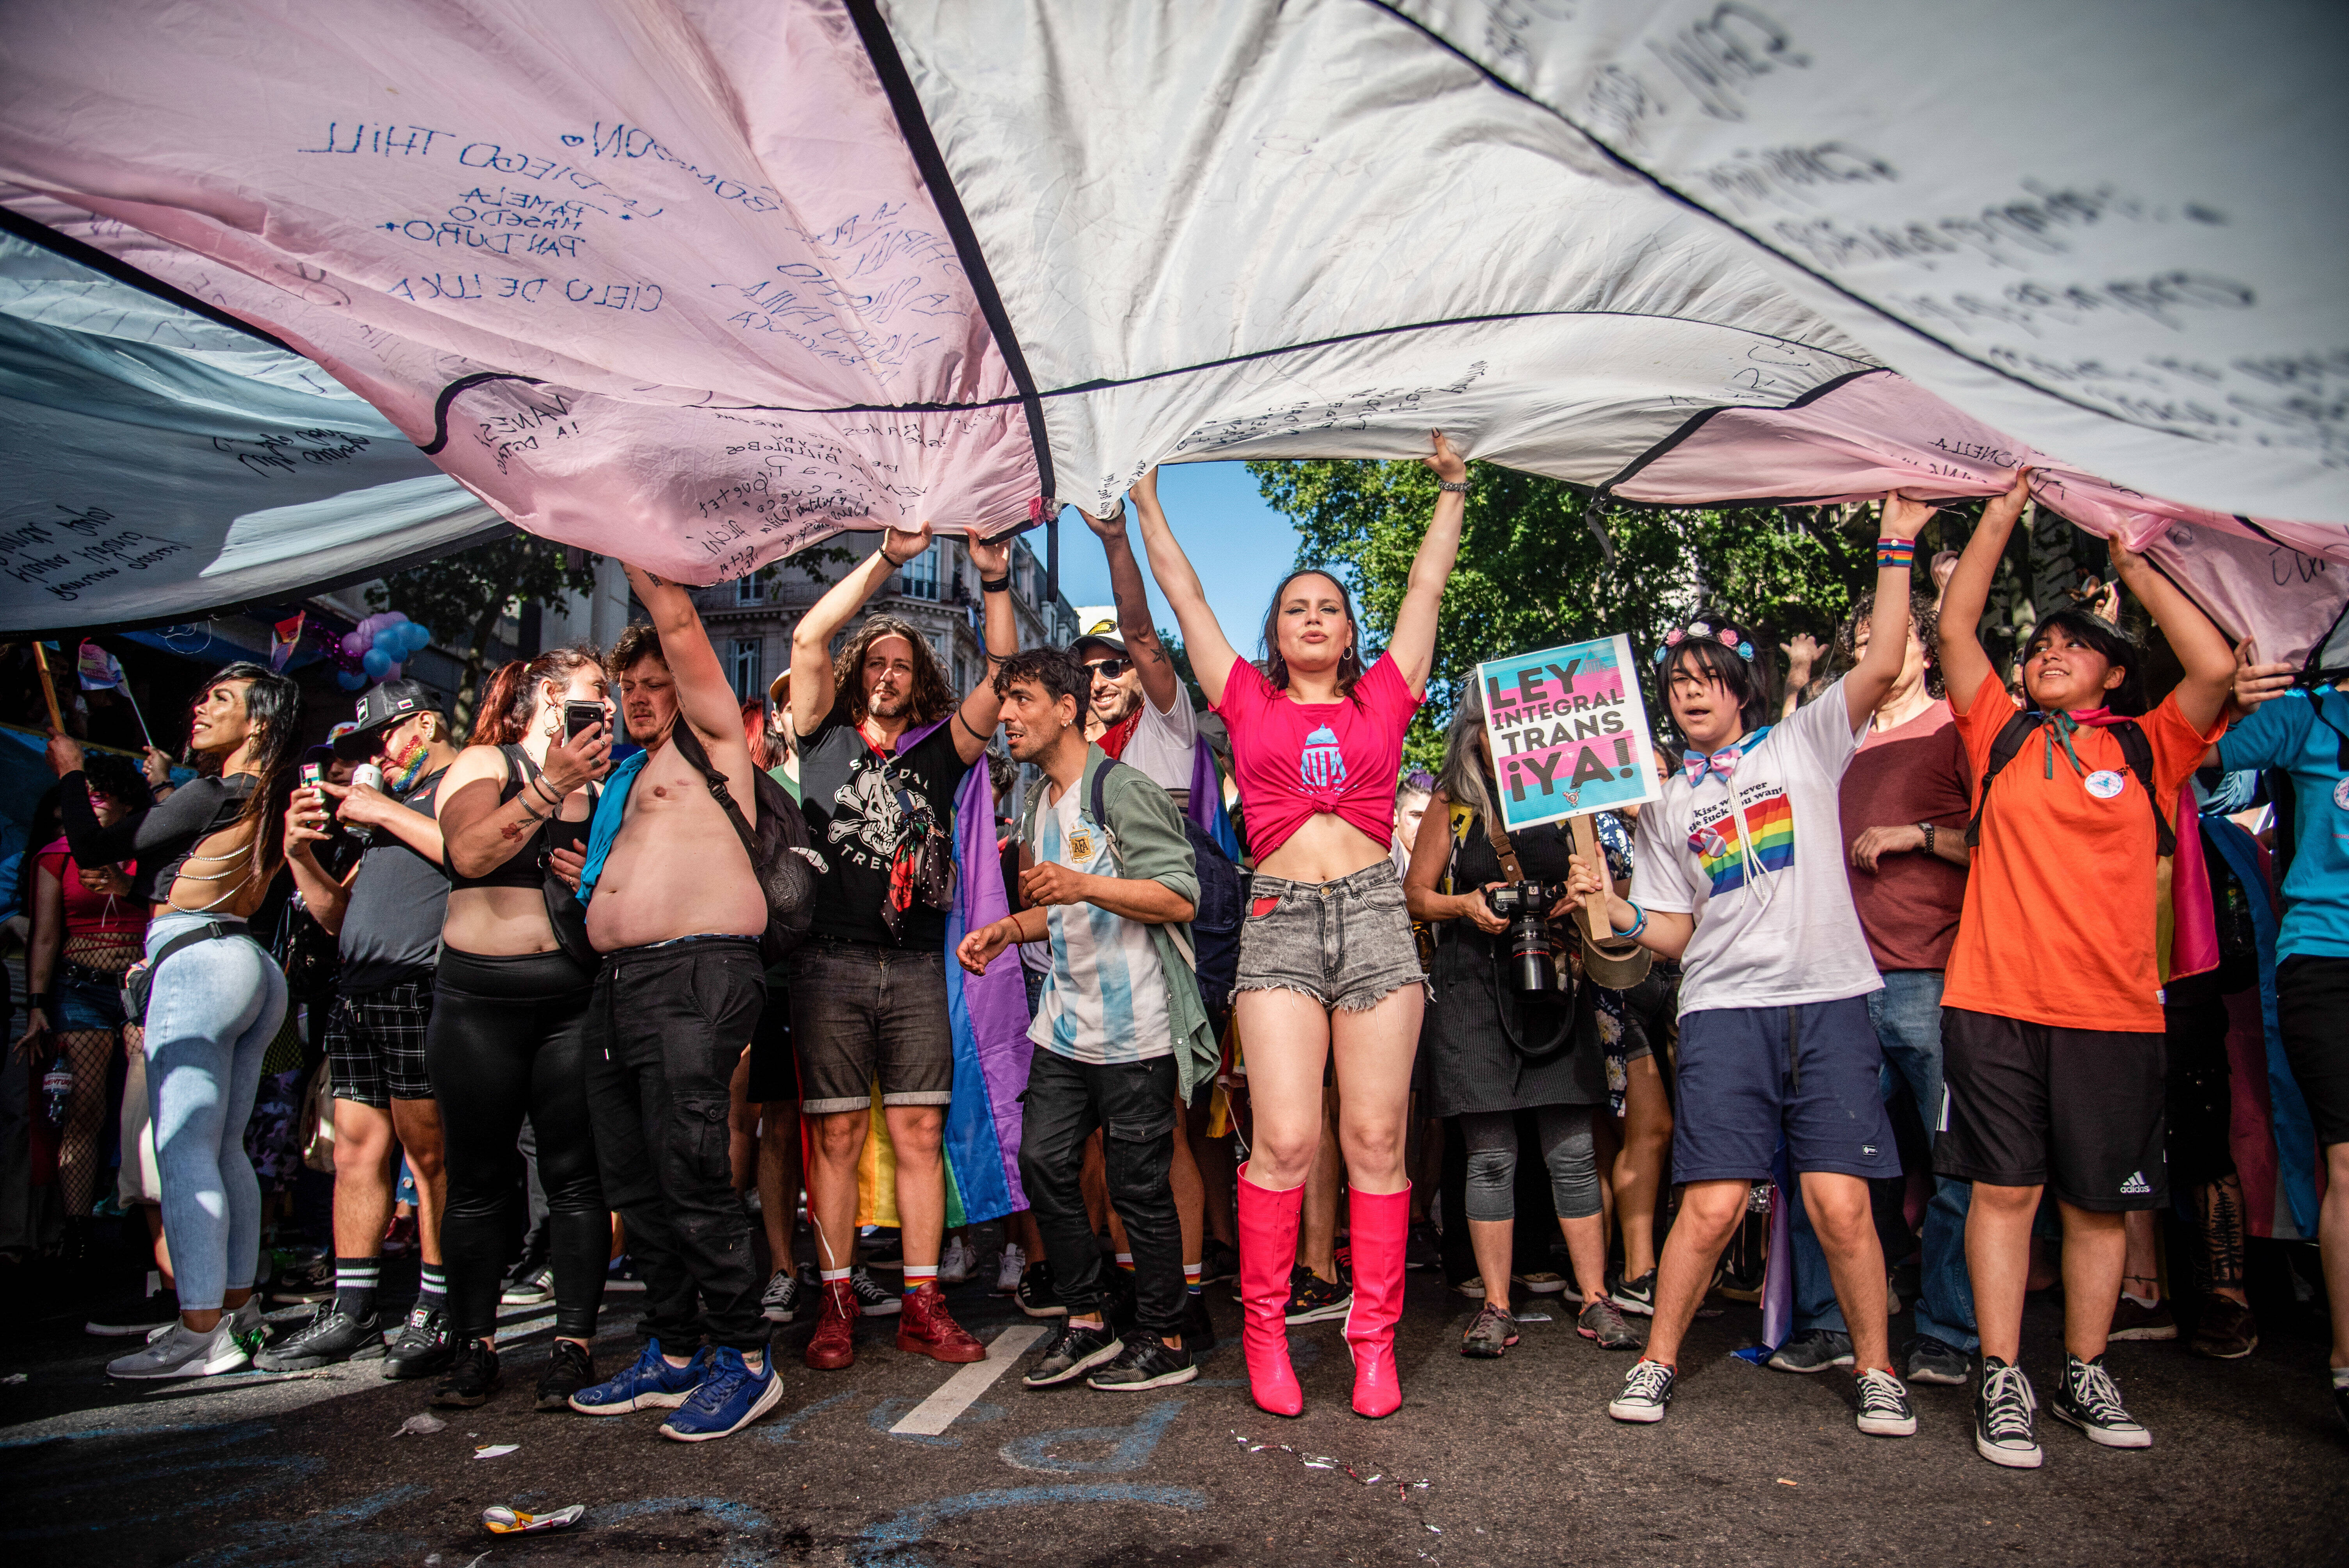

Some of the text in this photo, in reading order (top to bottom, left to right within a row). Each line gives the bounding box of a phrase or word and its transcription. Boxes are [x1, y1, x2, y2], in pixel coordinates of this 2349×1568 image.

[1488, 658, 1581, 710] LEY
[1492, 689, 1625, 731] INTEGRAL
[1501, 711, 1624, 755] TRANS
[1507, 738, 1633, 802] ¡YA!
[1693, 805, 1717, 818] Kiss
[1703, 809, 1729, 824] fuck
[2120, 1185, 2151, 1193] adidas
